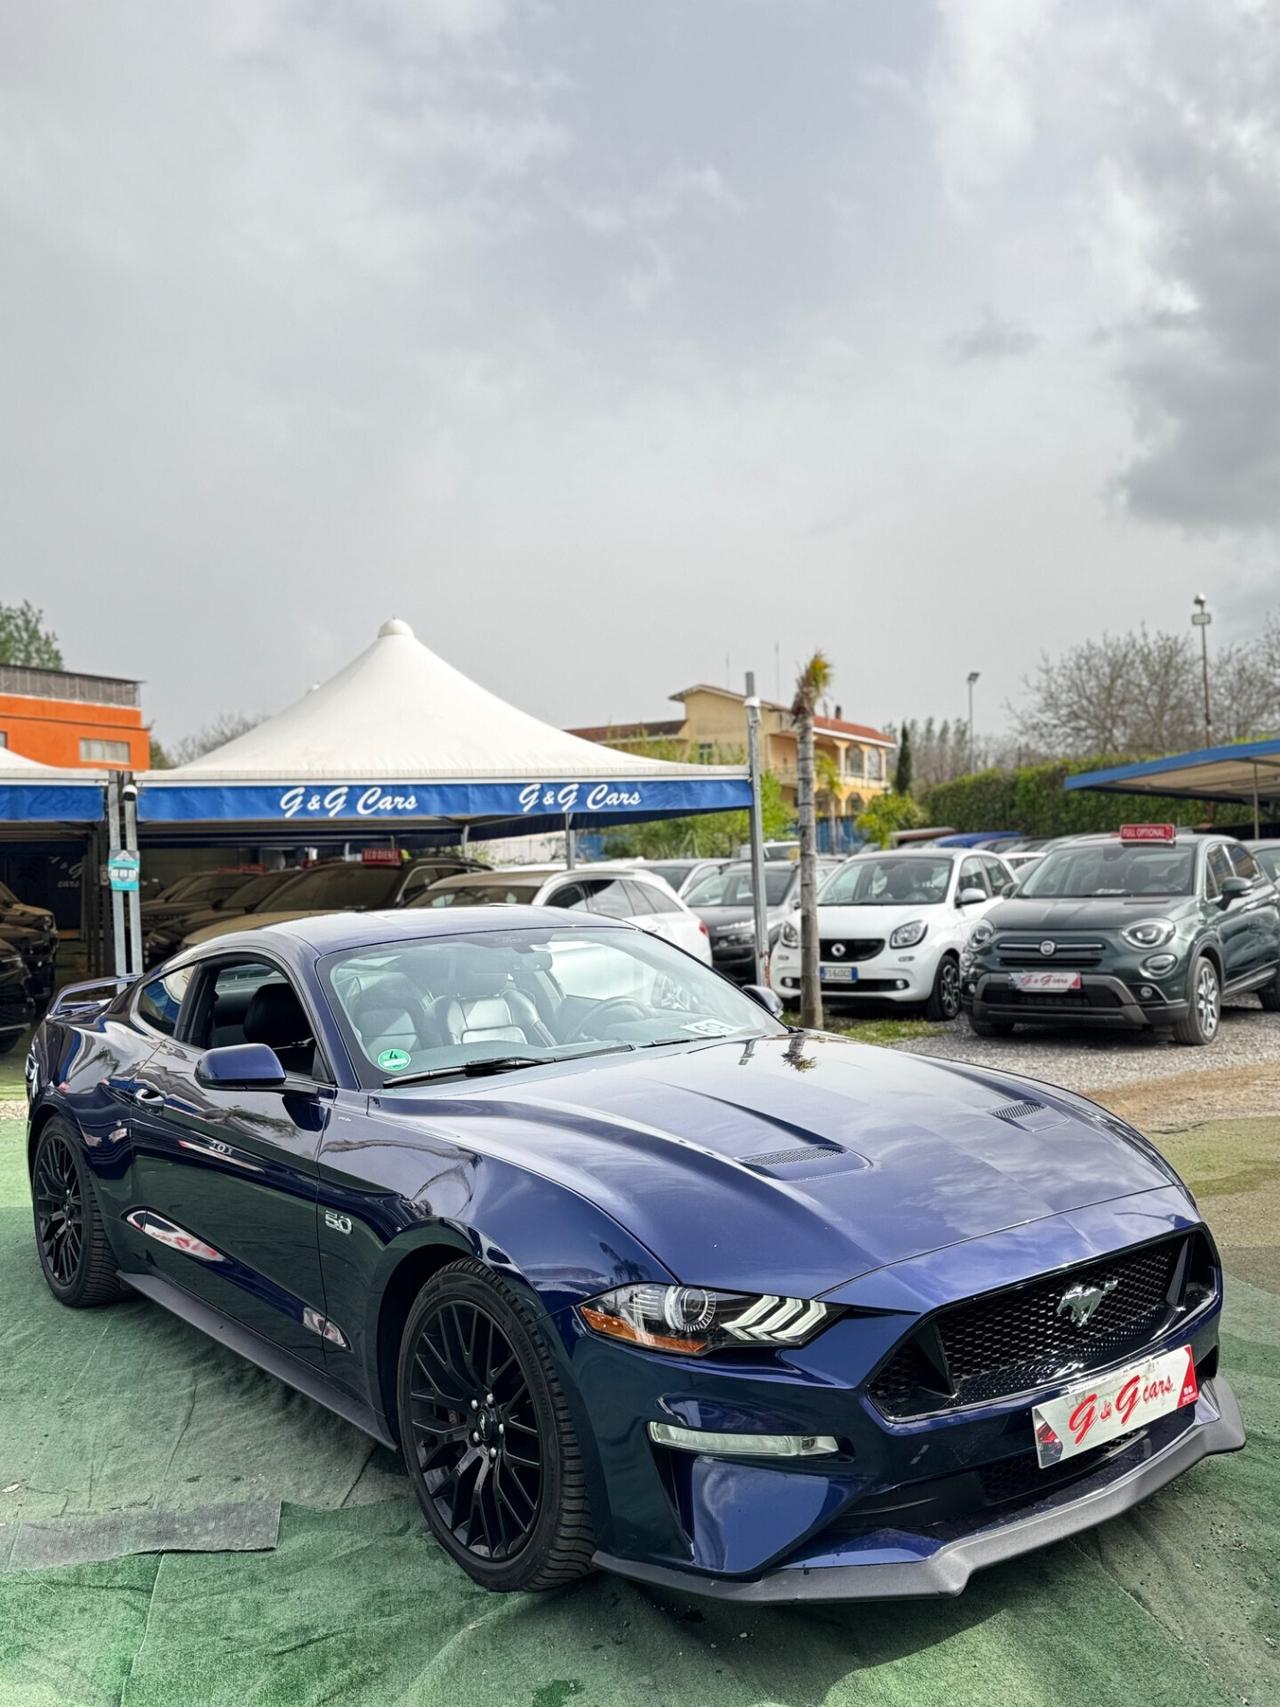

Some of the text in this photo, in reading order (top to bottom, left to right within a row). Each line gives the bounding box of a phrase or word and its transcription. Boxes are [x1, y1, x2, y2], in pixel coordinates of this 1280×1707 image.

[280, 786, 418, 818] G&G Cars
[519, 783, 641, 812] G&G Cars
[1136, 828, 1165, 838] OPTIONAL
[389, 1050, 398, 1059] 4
